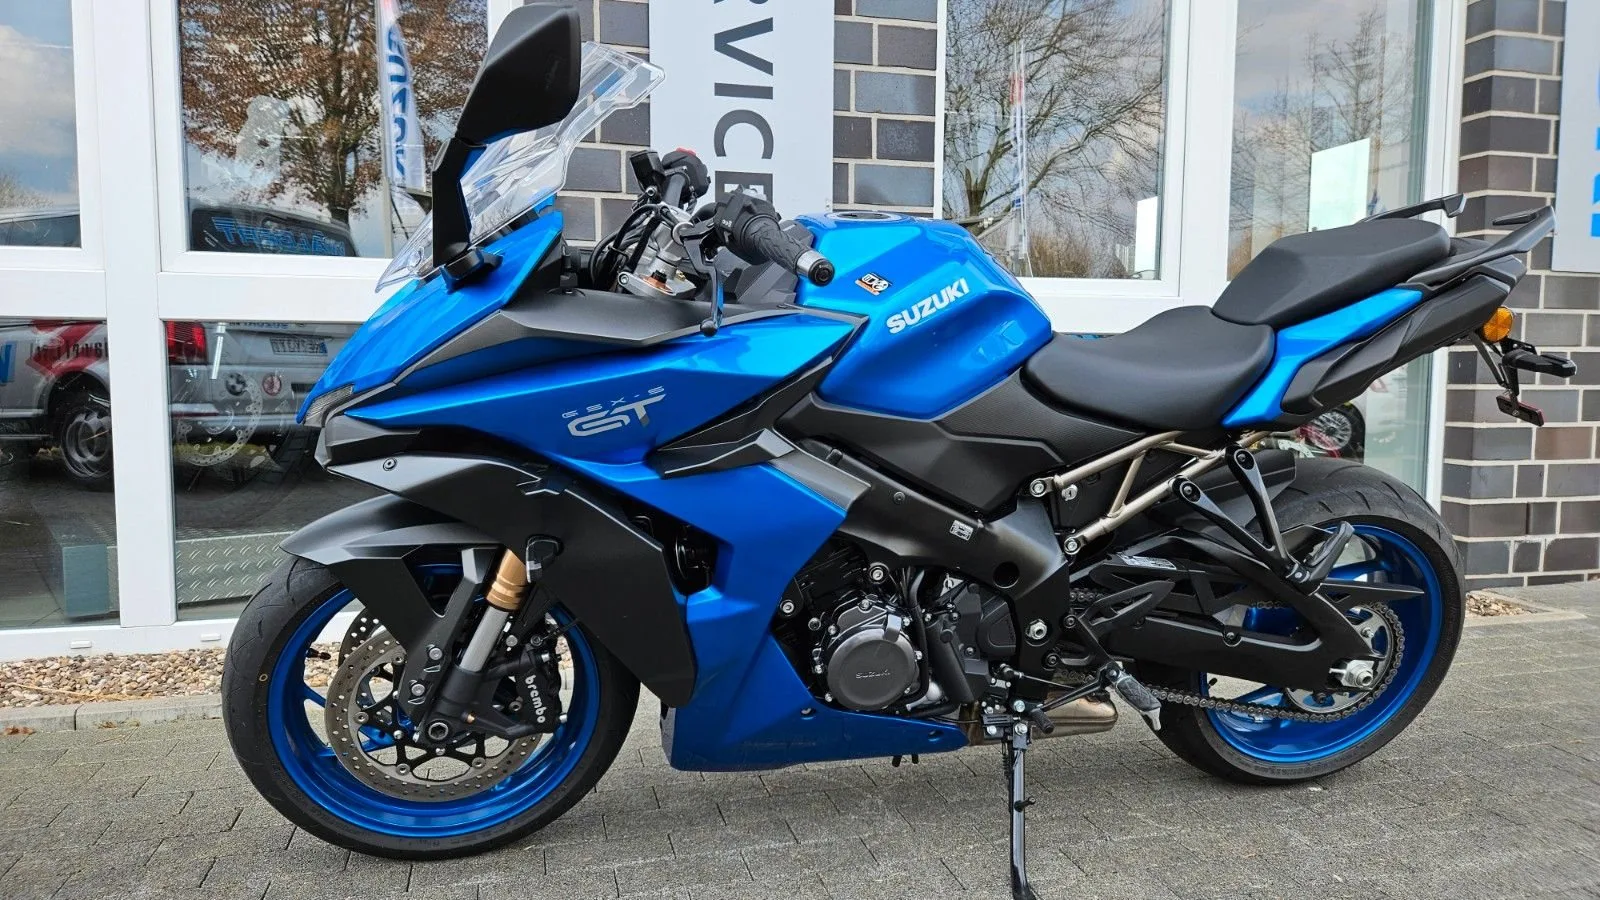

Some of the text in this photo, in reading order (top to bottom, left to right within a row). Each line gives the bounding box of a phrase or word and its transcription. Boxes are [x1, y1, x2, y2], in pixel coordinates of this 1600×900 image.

[714, 0, 774, 203] VICE
[886, 277, 970, 334] SUZUKI
[562, 386, 665, 419] GSX-S
[567, 394, 666, 437] GT
[525, 674, 547, 723] brembo
